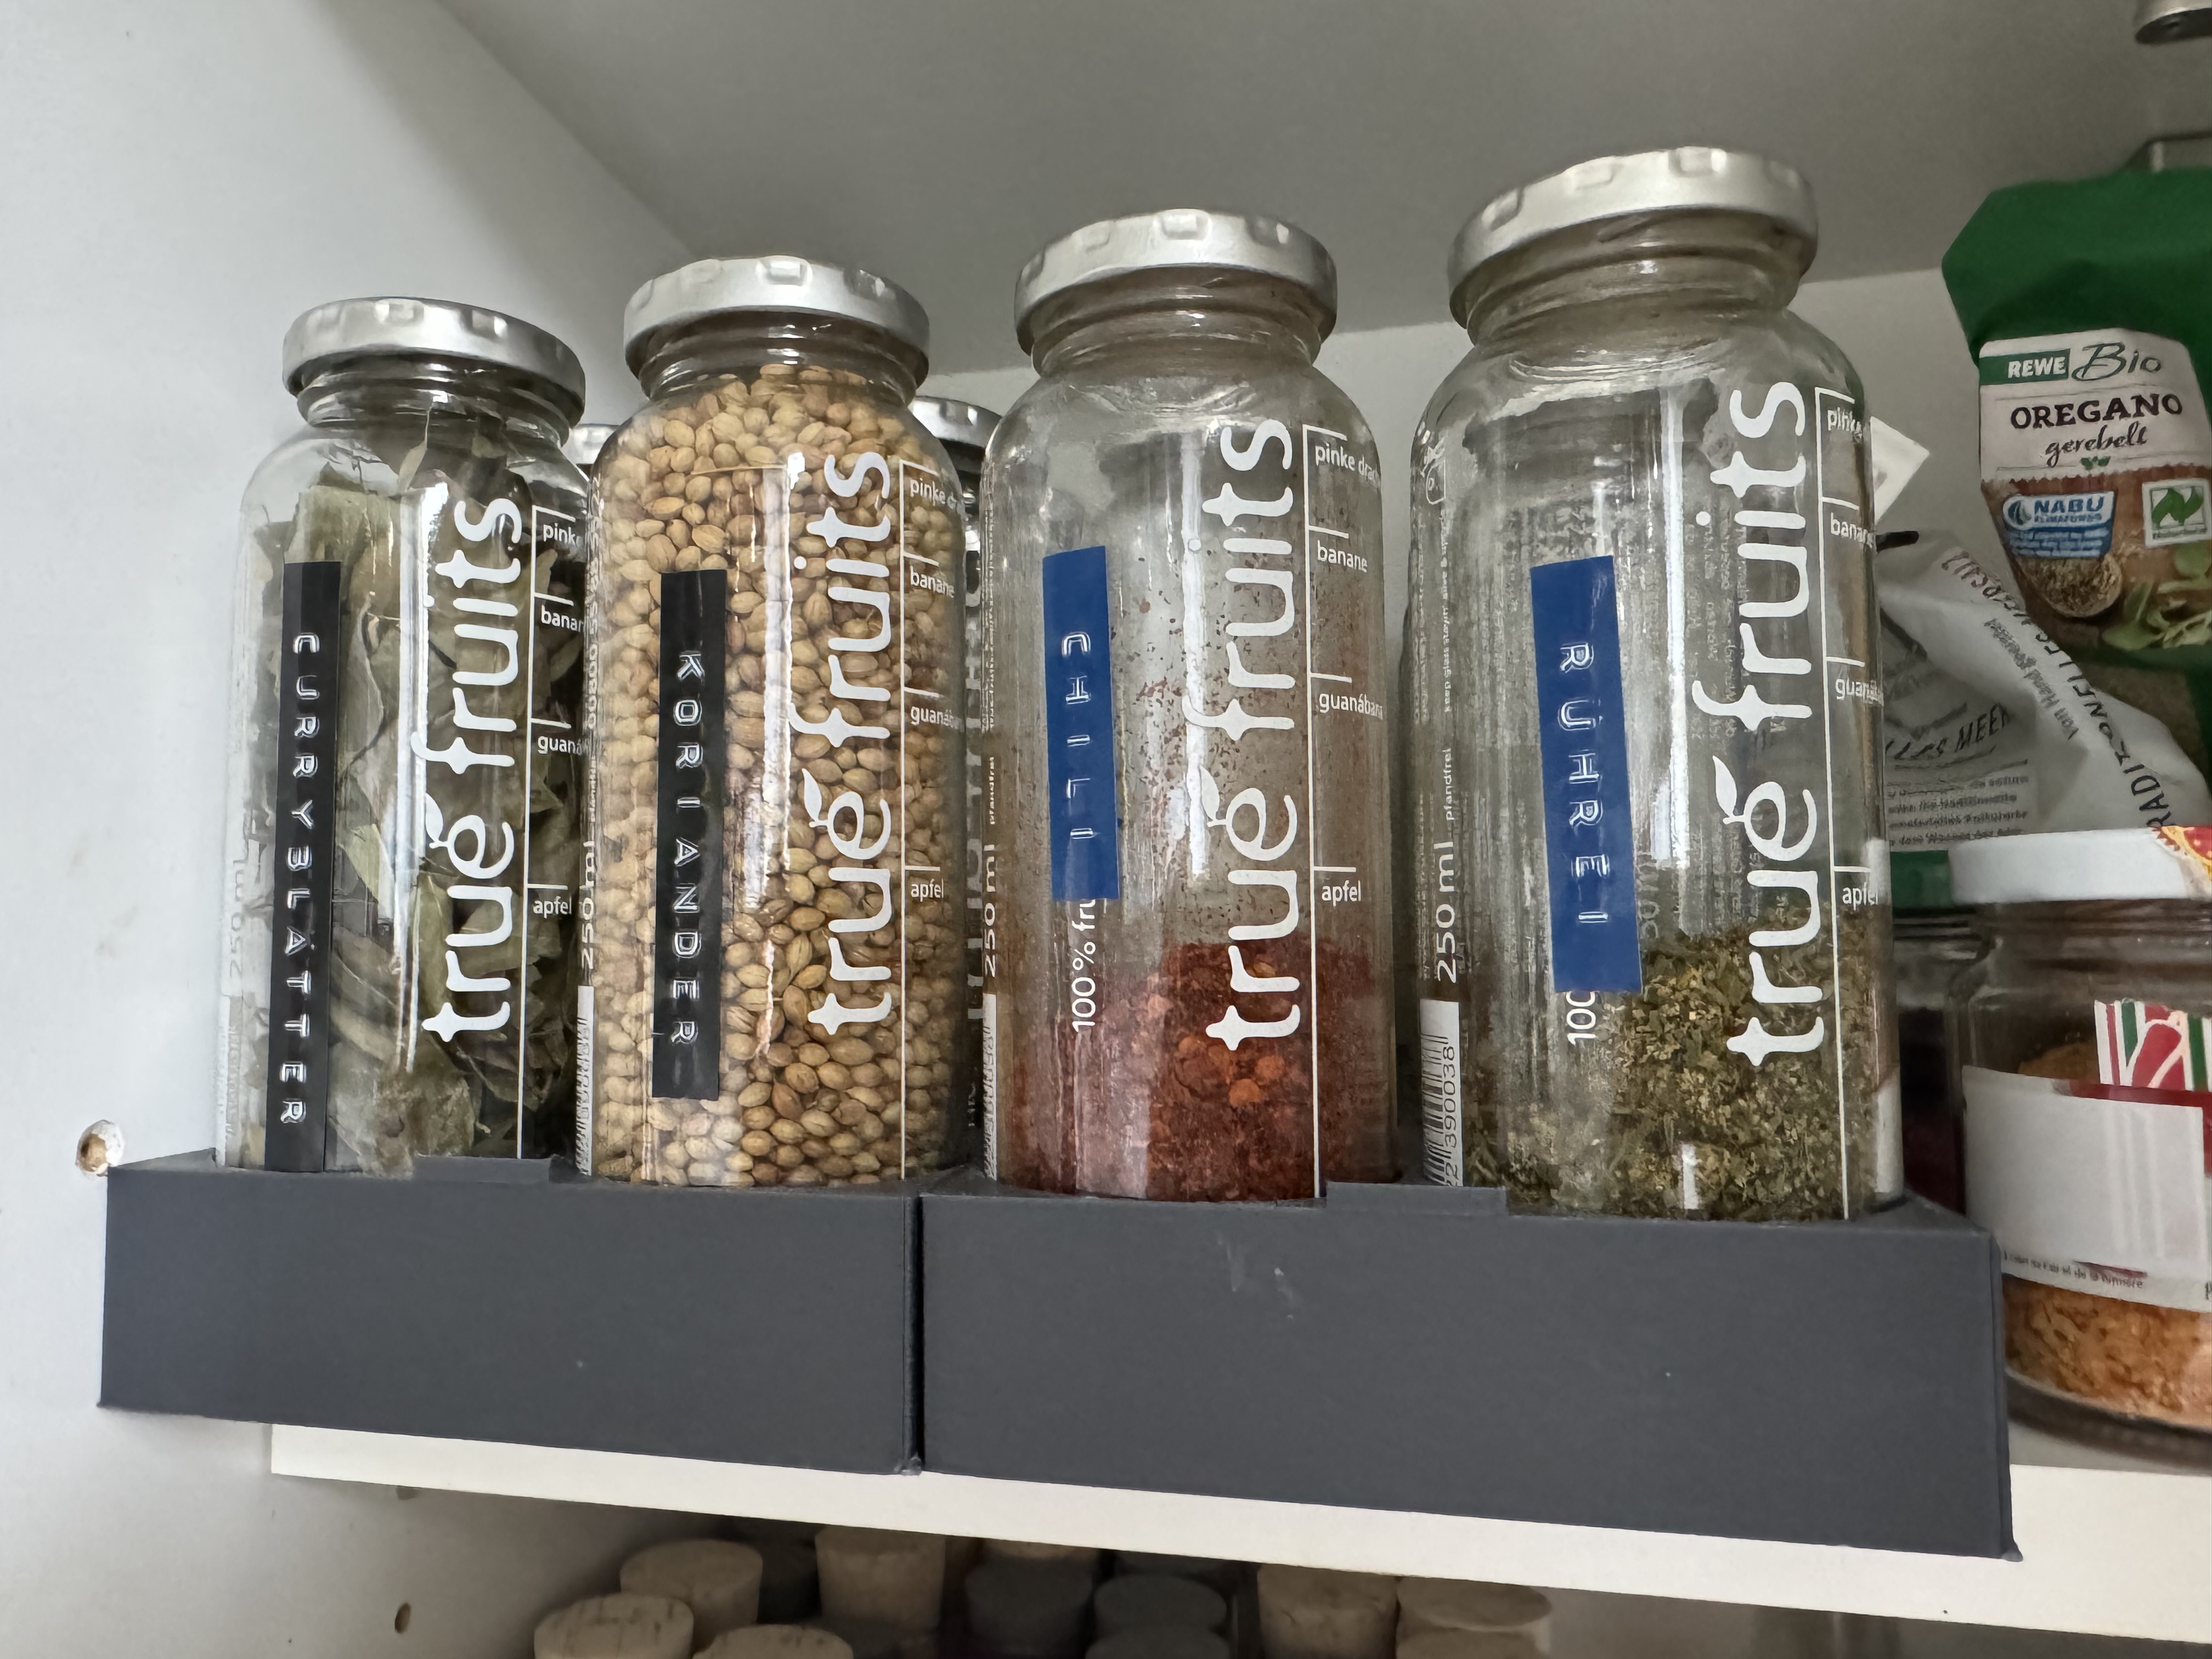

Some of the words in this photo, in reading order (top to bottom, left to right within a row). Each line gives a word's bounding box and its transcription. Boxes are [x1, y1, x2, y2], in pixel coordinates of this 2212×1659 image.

[2006, 356, 2066, 379] REWE
[2072, 342, 2162, 381] Bio
[2010, 393, 2182, 429] OREGANO
[1315, 443, 1355, 471] pinke
[2045, 422, 2147, 467] gerebelt
[910, 477, 946, 506] pinke
[2034, 496, 2104, 514] NABU
[910, 566, 955, 597] banane
[1182, 419, 1296, 741] fruits
[1317, 544, 1368, 572] banane
[1691, 381, 1812, 731] fruits
[788, 452, 892, 747] fruits
[410, 497, 523, 775] fruits
[1061, 631, 1093, 840] CHILI
[582, 840, 597, 887] ml
[670, 651, 705, 1043] KORIANDER
[983, 844, 997, 893] ml
[1434, 842, 1454, 893] ml
[533, 895, 572, 918] apfel
[807, 791, 892, 1035] true
[910, 879, 944, 900] apfel
[1322, 881, 1362, 907] apfel
[421, 814, 515, 1042] true
[581, 897, 594, 969] 250
[982, 902, 996, 978] 250
[1205, 787, 1301, 1051] true
[1435, 904, 1457, 984] 250
[1726, 781, 1825, 1066] true
